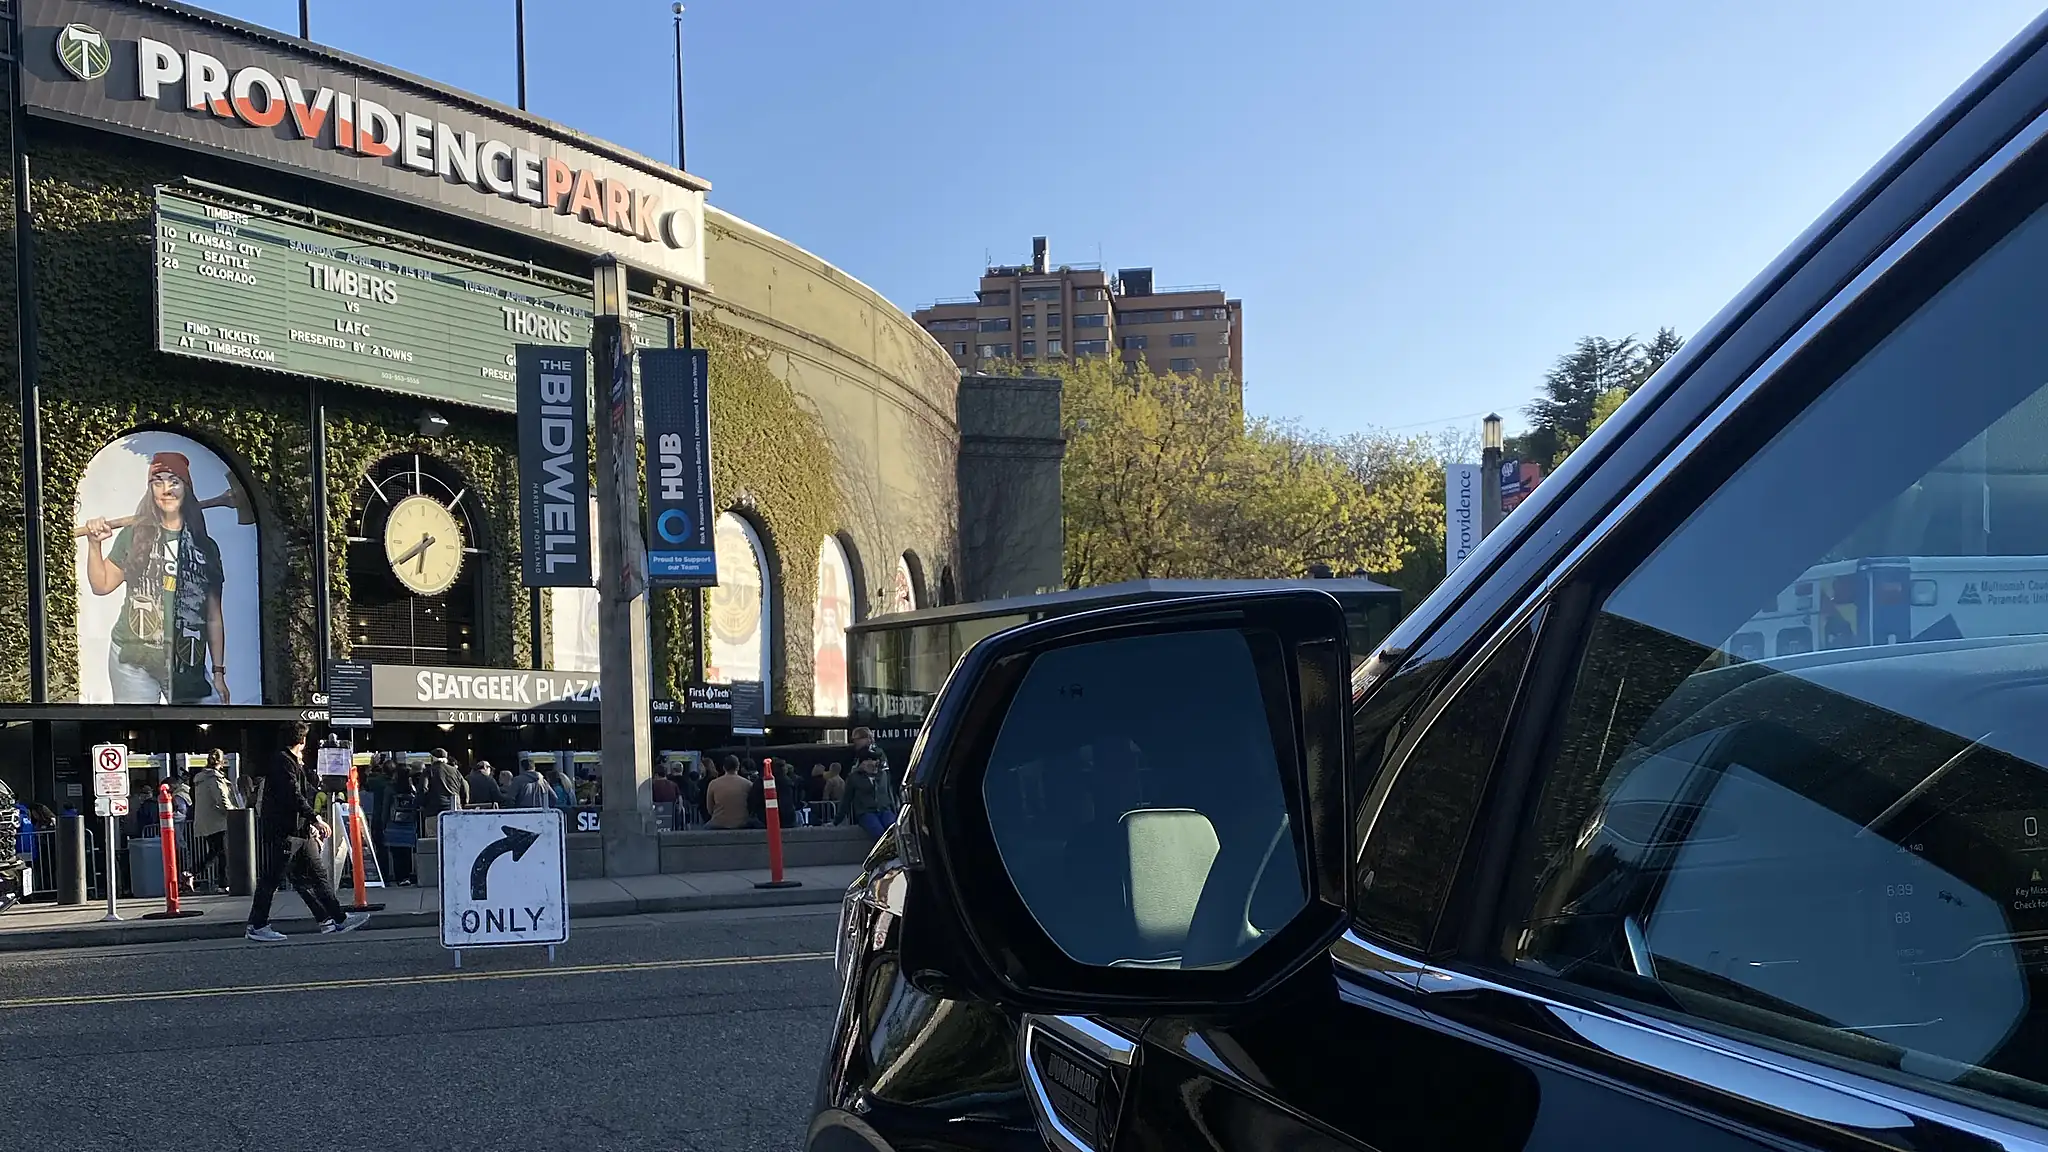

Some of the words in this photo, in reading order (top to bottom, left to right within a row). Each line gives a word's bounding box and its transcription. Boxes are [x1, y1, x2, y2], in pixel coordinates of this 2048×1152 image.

[138, 37, 542, 202] PROVIDENCE
[542, 157, 661, 242] PARK
[204, 205, 249, 225] TIMBERS
[163, 226, 178, 238] 10
[189, 231, 233, 251] KANSAS
[238, 243, 262, 258] CITY
[215, 222, 238, 237] MAY
[163, 242, 176, 253] 17
[204, 250, 250, 270] SEATTLE
[289, 240, 336, 259] SATURDAY
[346, 253, 375, 268] APRIL
[380, 260, 390, 271] 19
[417, 269, 432, 281] PM
[163, 256, 179, 269] 28
[198, 264, 257, 285] COLORADO
[307, 261, 399, 304] TIMBERS
[346, 301, 360, 313] VS
[463, 280, 500, 299] TUESDAY
[505, 291, 530, 305] APRIL
[533, 298, 545, 308] 22
[573, 308, 586, 318] PM
[186, 321, 211, 336] FIND
[218, 327, 260, 345] TICKETS
[336, 318, 371, 337] LAFC
[501, 305, 572, 343] THORNS
[179, 335, 195, 348] AT
[206, 340, 275, 362] TIMBERS.COM
[290, 329, 346, 349] PRESENTED
[353, 341, 366, 353] BY
[371, 344, 379, 355] 2
[381, 346, 413, 361] TOWNS
[540, 359, 572, 371] THE
[540, 373, 577, 574] BIDWELL
[659, 433, 684, 500] HUB
[1456, 470, 1471, 561] Providence
[683, 556, 711, 564] Support
[312, 692, 329, 704] Ga
[416, 670, 532, 704] SEATGEEK
[535, 677, 601, 702] PLAZA
[689, 687, 705, 697] First
[713, 688, 729, 698] Tech
[449, 711, 483, 722] 20TH
[493, 711, 500, 722] &
[511, 712, 578, 723] MORRISON
[652, 701, 669, 710] Gate
[691, 701, 704, 709] First
[714, 702, 732, 710] Membe
[2014, 901, 2037, 910] Check
[2015, 888, 2030, 898] Key
[461, 907, 546, 934] ONLY
[1895, 911, 1911, 924] 63
